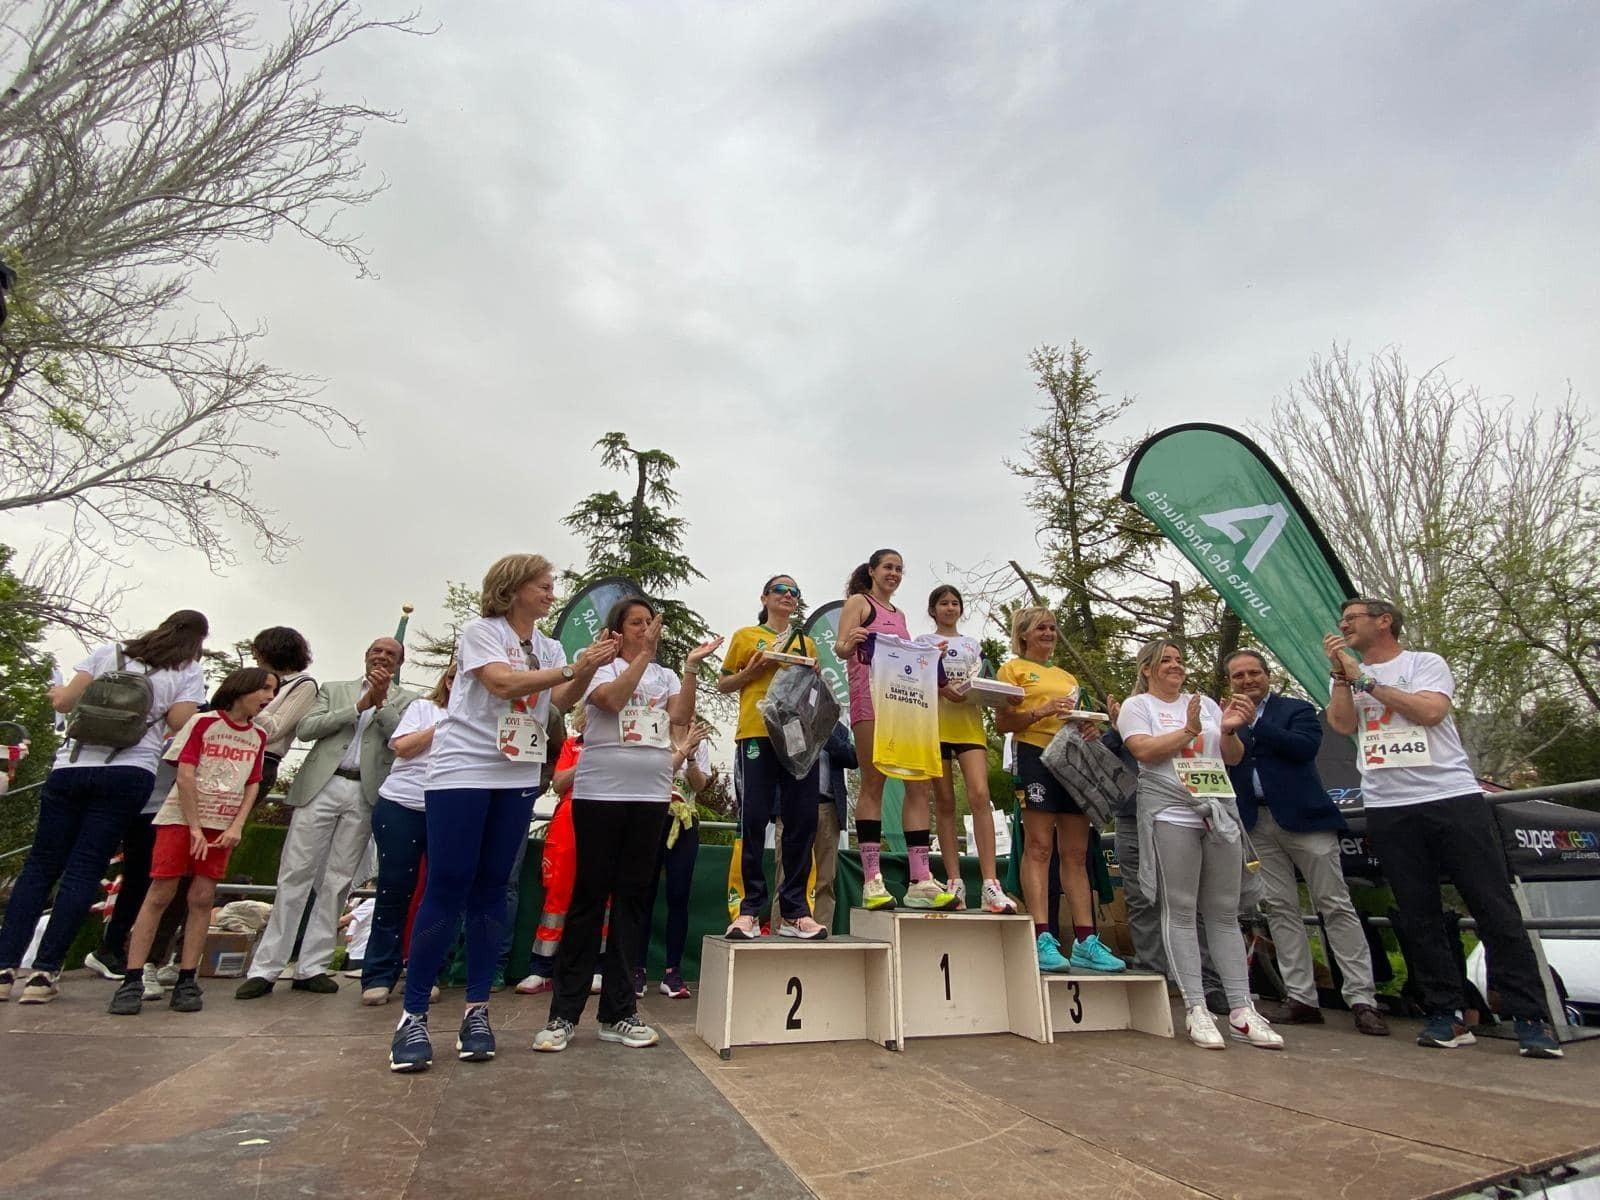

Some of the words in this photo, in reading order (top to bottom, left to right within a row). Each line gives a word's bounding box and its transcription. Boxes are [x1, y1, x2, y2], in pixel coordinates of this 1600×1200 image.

[890, 687, 908, 696] SANTA
[505, 717, 520, 726] XXVI
[652, 722, 658, 734] 1
[530, 734, 538, 747] 2
[1378, 741, 1426, 755] 1448
[1190, 773, 1228, 785] 5781
[940, 953, 951, 1001] 1
[786, 976, 803, 1030] 2
[1067, 980, 1083, 1024] 3
